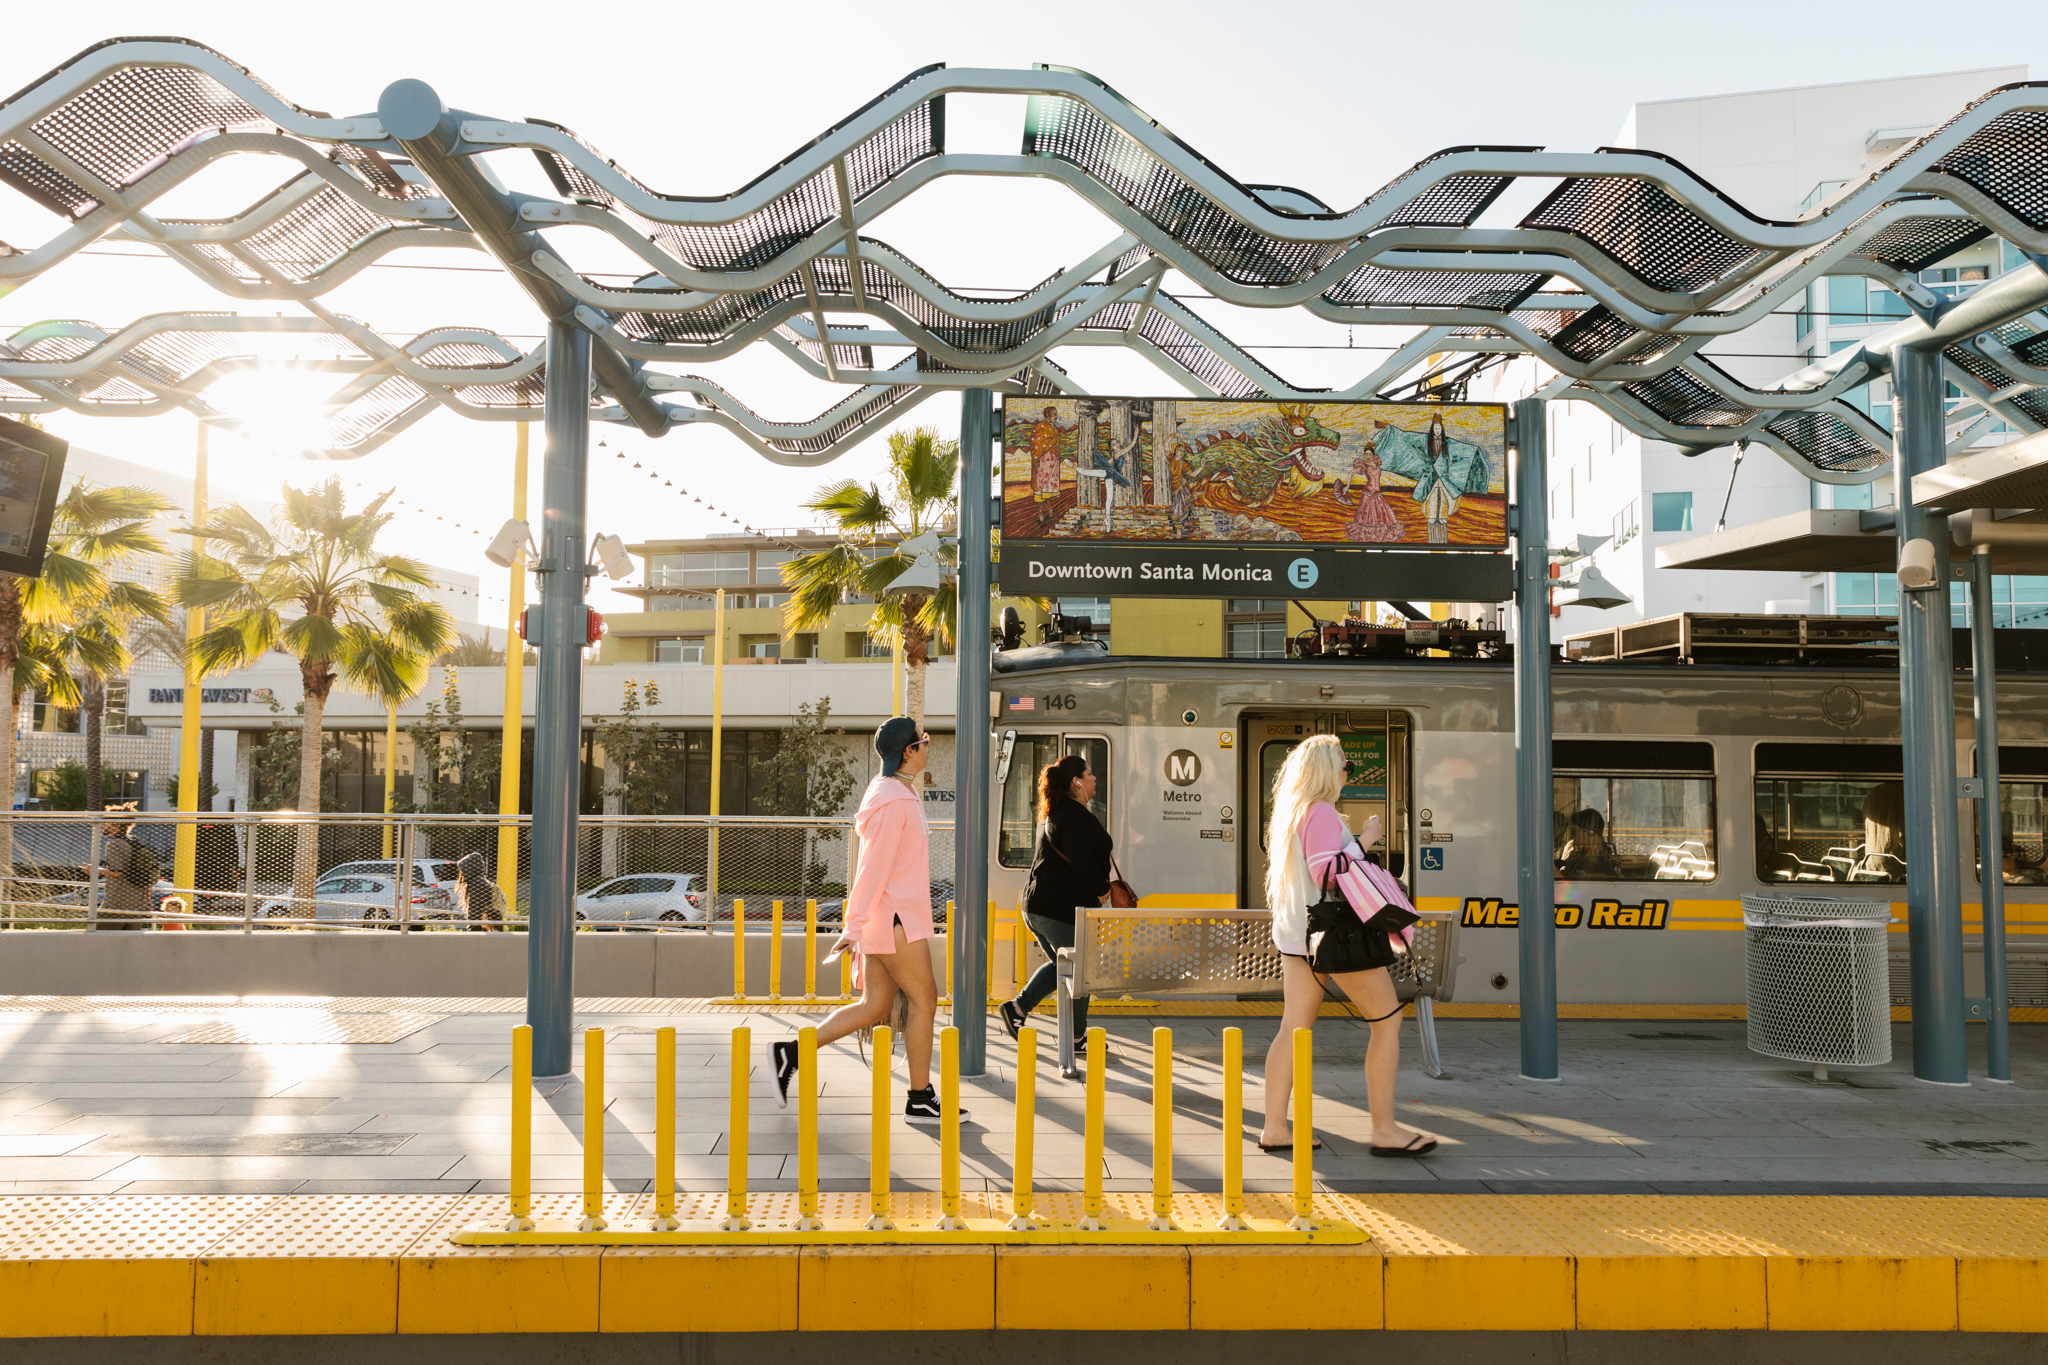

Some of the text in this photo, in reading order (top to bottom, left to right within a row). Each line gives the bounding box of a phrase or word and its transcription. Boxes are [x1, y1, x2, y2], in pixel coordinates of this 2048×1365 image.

[1028, 560, 1310, 583] Downtown Santa Monica E
[148, 688, 184, 703] BAN
[204, 688, 252, 703] WEST
[1042, 694, 1077, 711] 146
[1340, 741, 1377, 749] EADS UP!
[1345, 751, 1380, 759] TCH FOR
[928, 790, 955, 802] WES
[1163, 790, 1202, 802] Metro
[1461, 897, 1669, 930] Meo Rail
